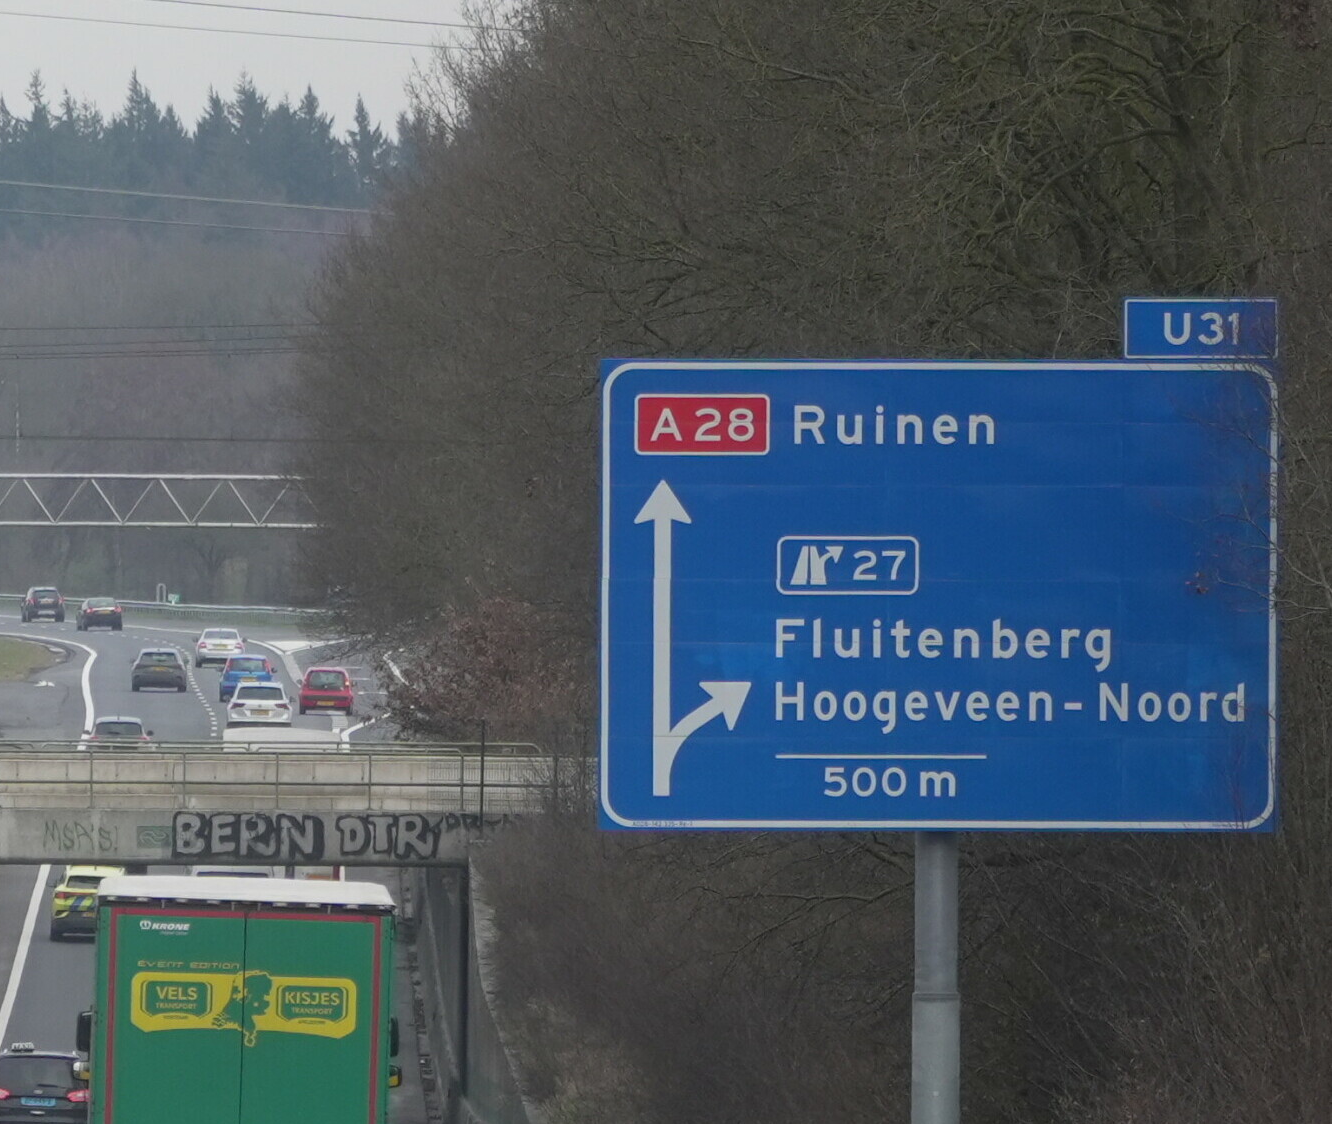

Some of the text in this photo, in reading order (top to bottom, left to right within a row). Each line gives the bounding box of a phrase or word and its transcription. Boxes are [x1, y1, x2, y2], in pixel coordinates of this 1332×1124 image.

[1163, 312, 1241, 346] U31
[650, 408, 755, 442] A28
[793, 405, 996, 445] Ruinen
[852, 551, 907, 581] 27
[775, 619, 1113, 671] Fluitenberg
[775, 682, 1246, 734] Hoogeveen-Noord
[823, 767, 957, 798] 500 m
[152, 922, 190, 930] KRONE
[155, 985, 198, 1001] VELS
[284, 991, 341, 1006] KISJES
